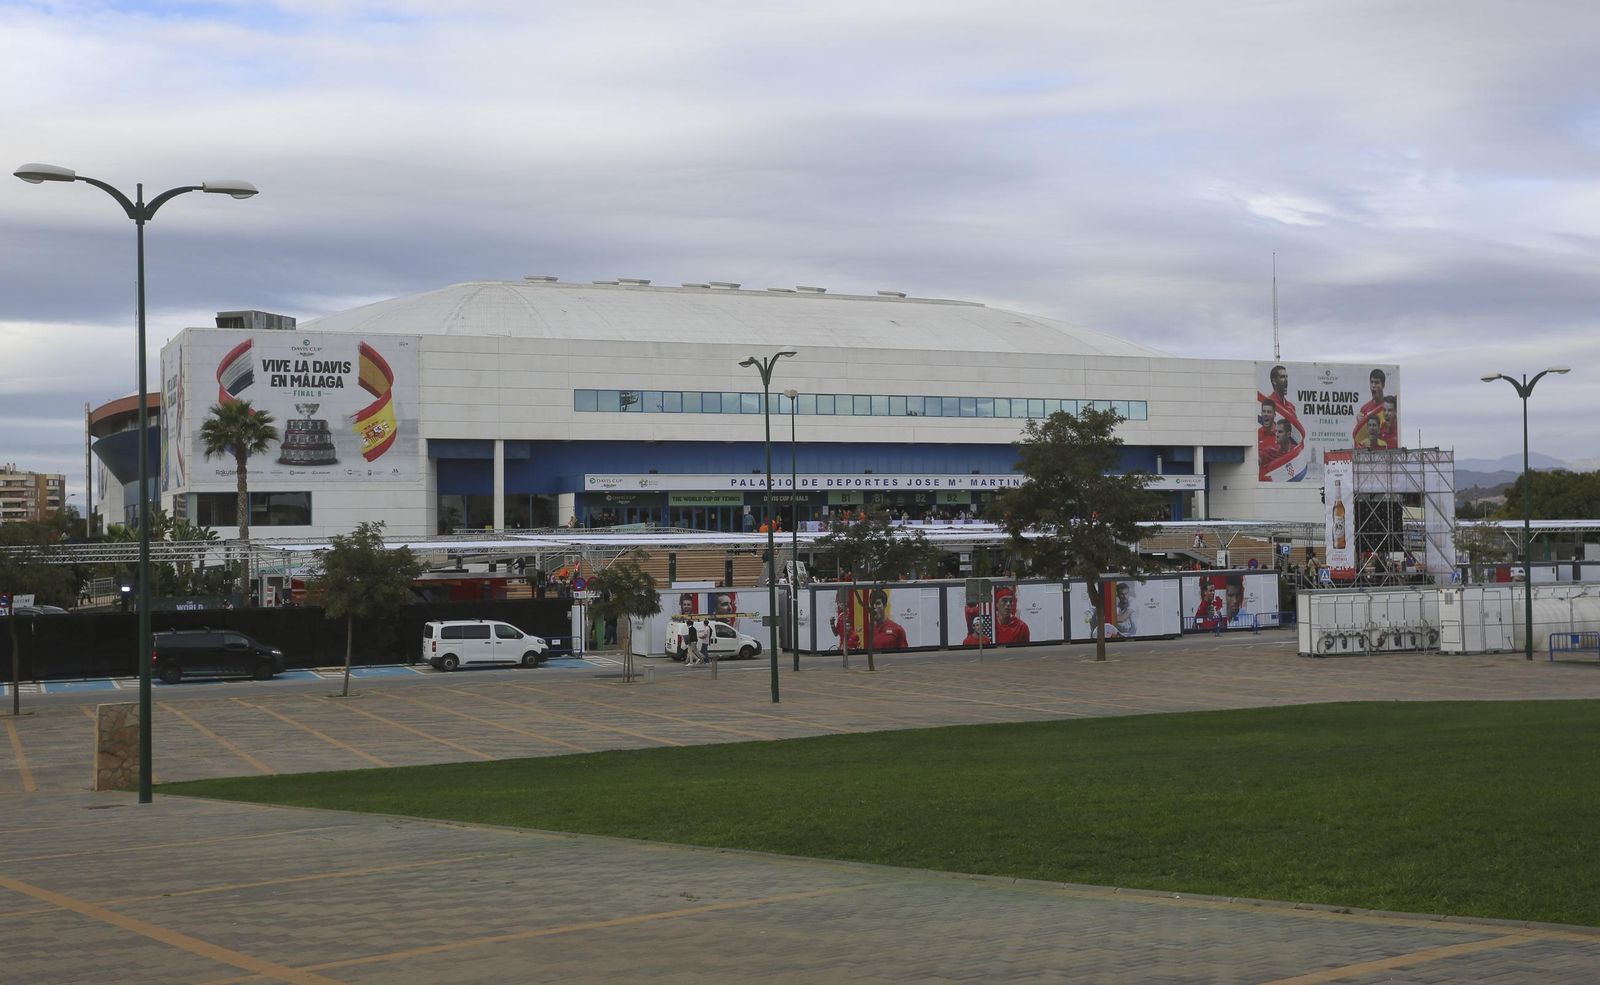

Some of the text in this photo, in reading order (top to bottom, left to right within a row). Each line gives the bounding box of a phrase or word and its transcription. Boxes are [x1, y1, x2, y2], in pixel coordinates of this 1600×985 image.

[262, 359, 351, 374] VIVE LA DAVIS
[270, 373, 344, 388] EN MÁLAGA
[1297, 390, 1359, 403] VIVE LA DAVIS
[1303, 402, 1354, 416] EN MÁLAGA
[731, 478, 792, 486] PALACIO
[802, 478, 818, 486] DE
[827, 478, 898, 486] DEPORTES
[907, 478, 940, 486] JOSE
[970, 478, 1020, 486] MARTIN
